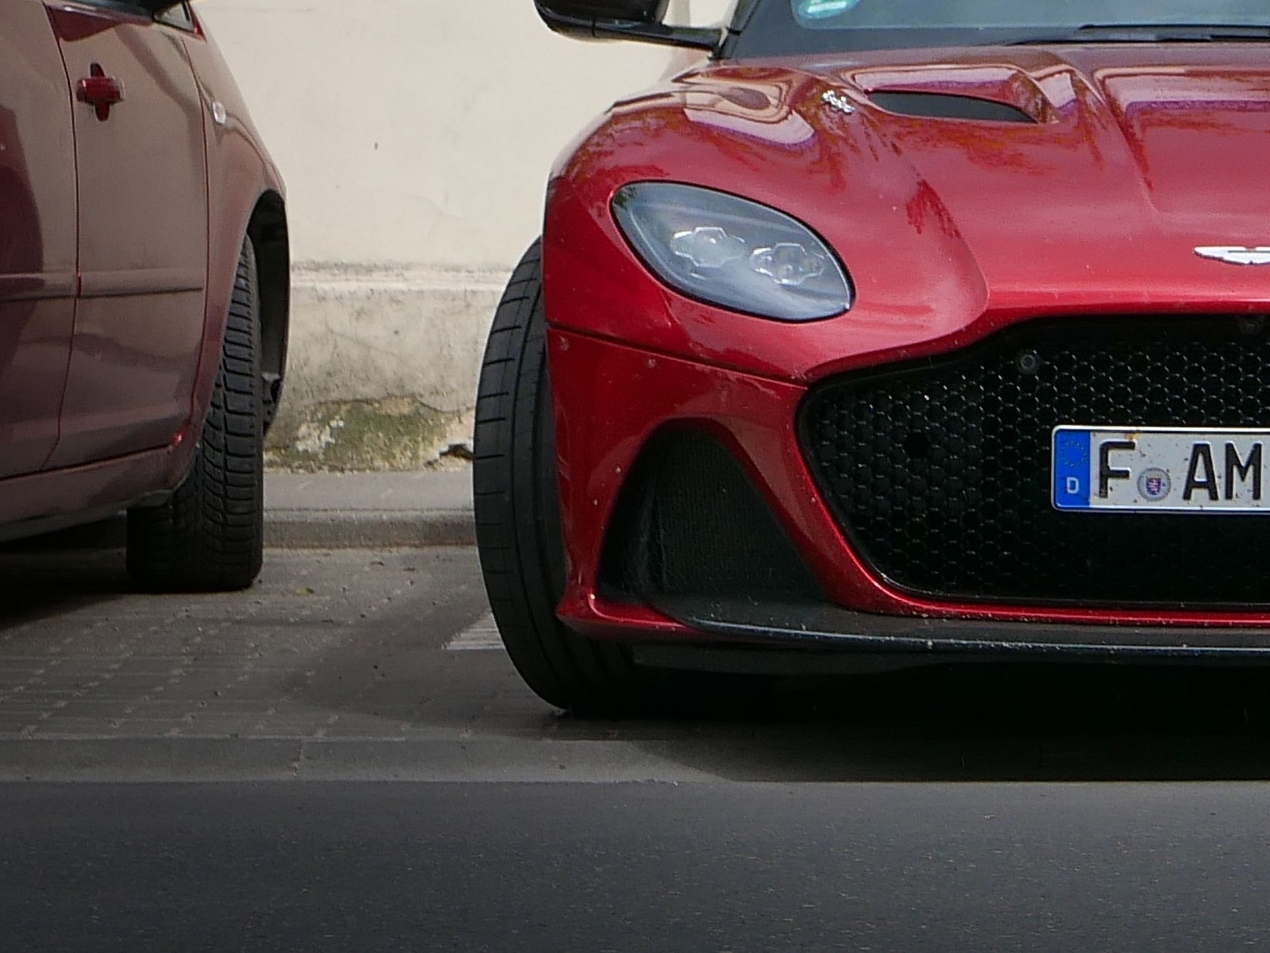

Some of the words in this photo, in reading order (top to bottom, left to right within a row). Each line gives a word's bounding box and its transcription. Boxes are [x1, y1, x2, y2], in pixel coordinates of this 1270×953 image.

[1066, 476, 1080, 495] D
[1098, 440, 1136, 499] F
[1182, 443, 1262, 502] AM
